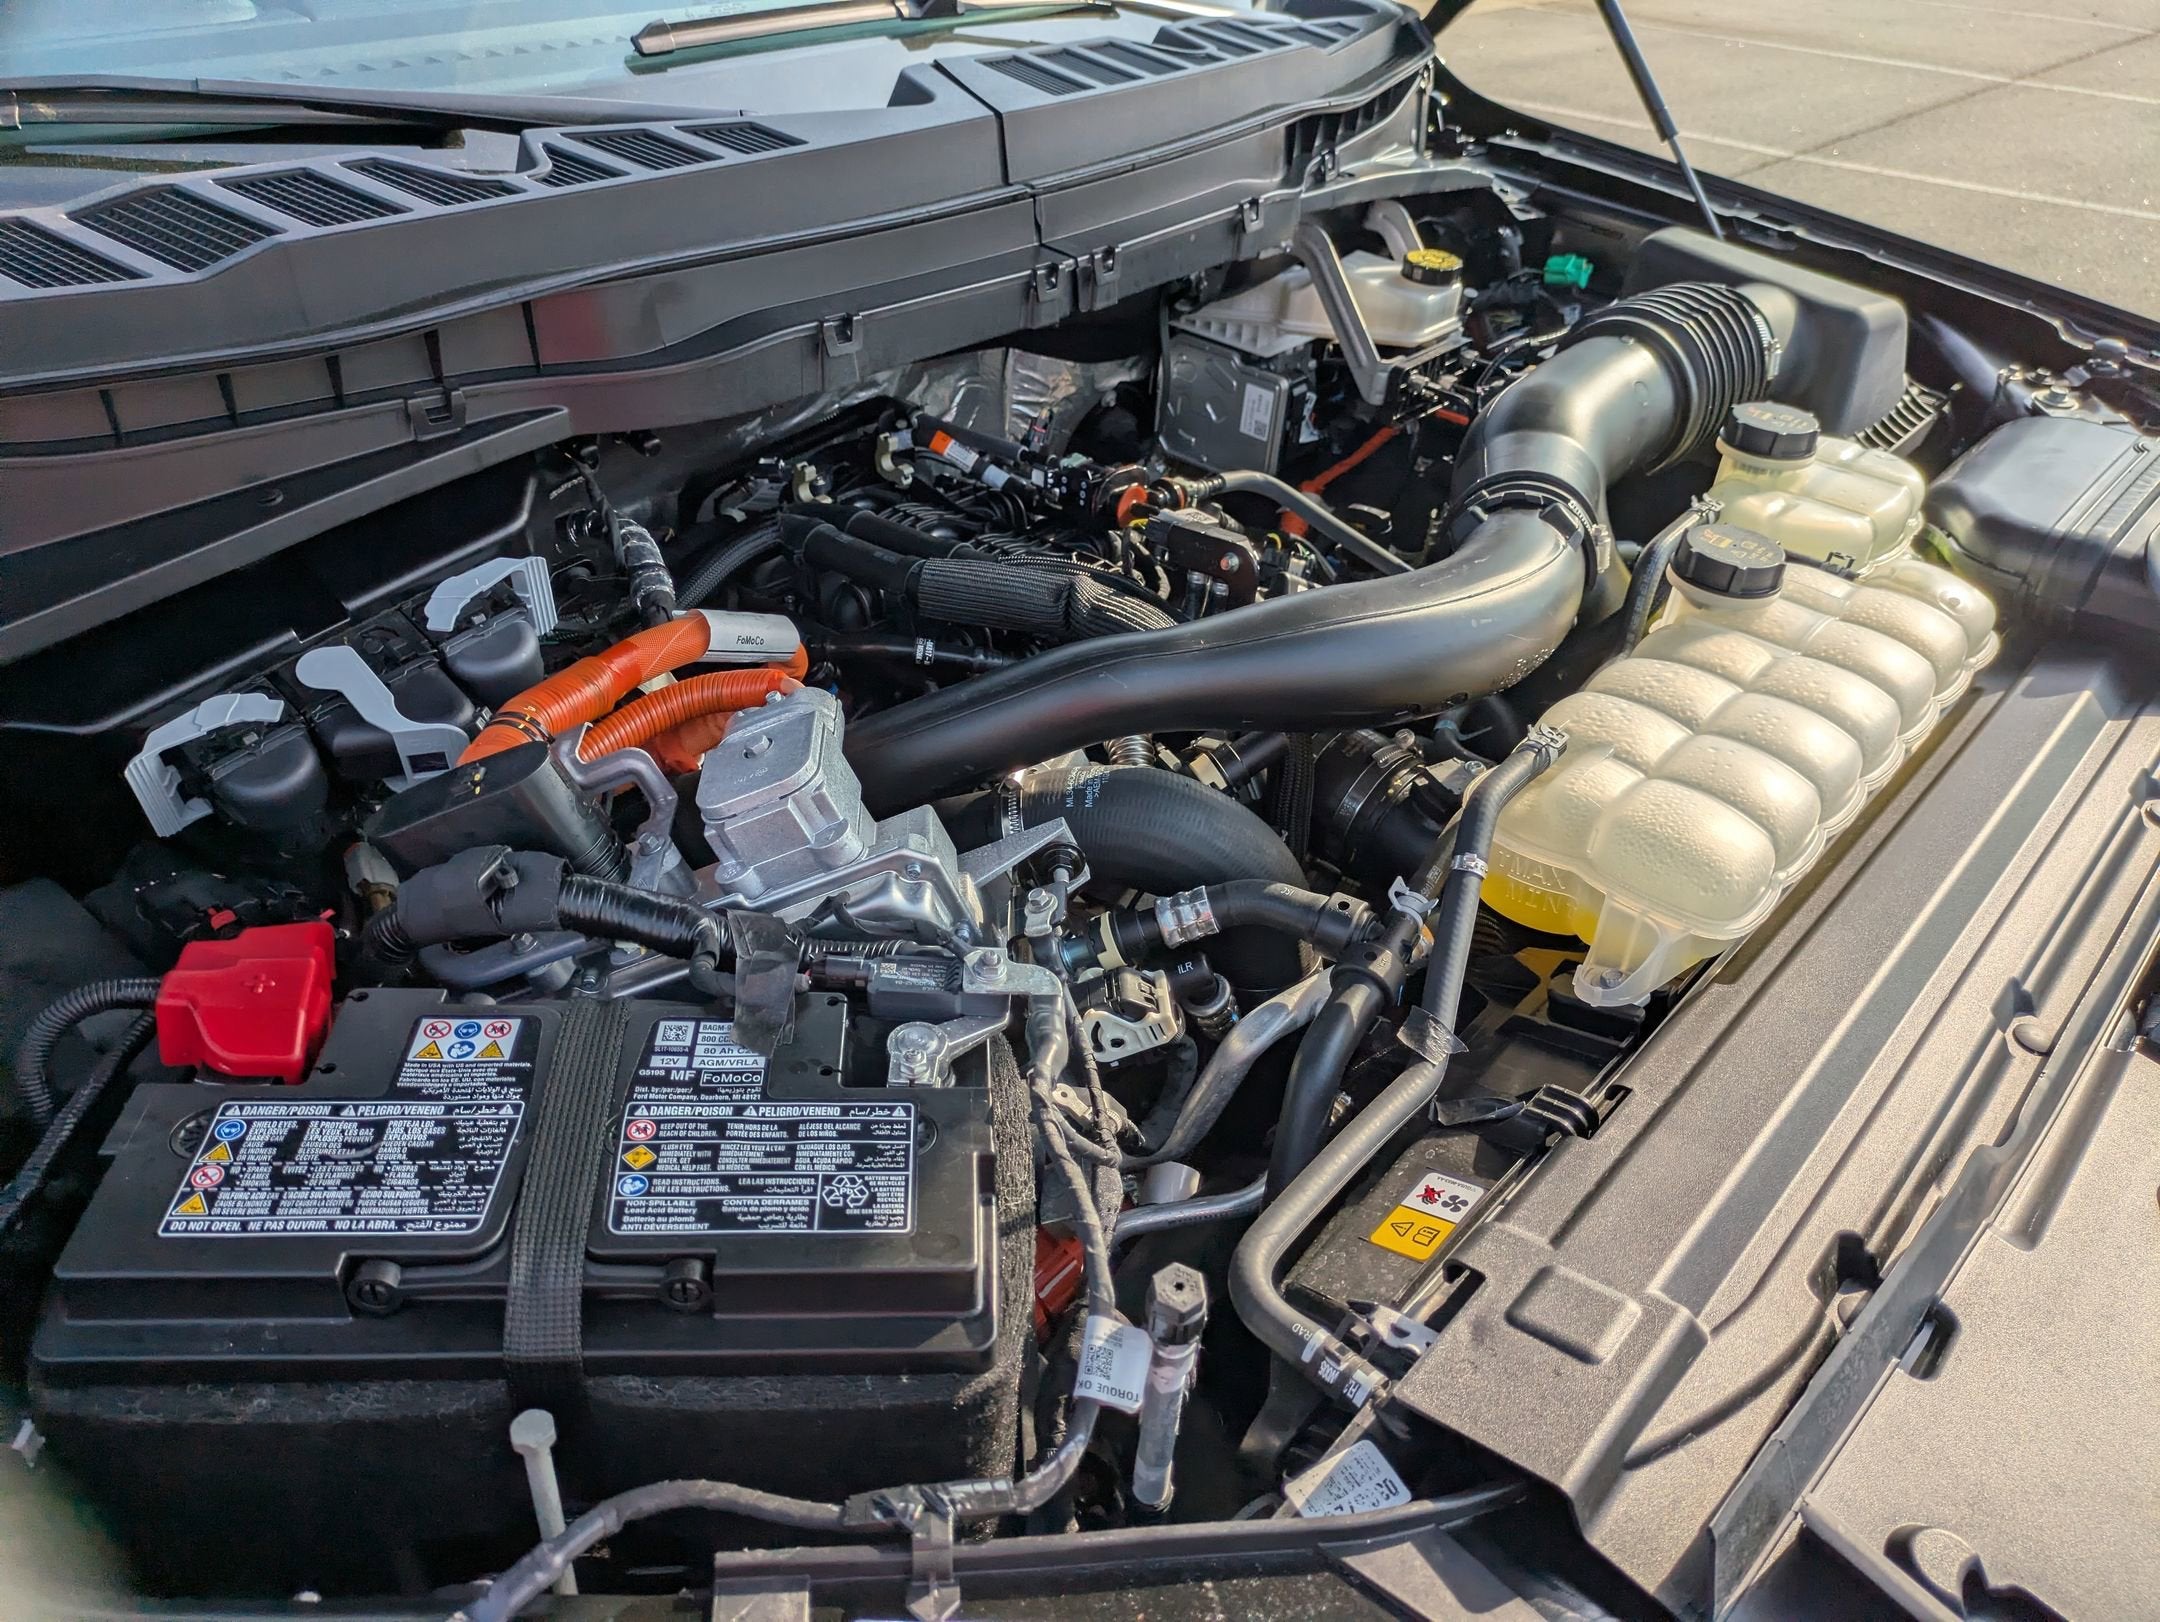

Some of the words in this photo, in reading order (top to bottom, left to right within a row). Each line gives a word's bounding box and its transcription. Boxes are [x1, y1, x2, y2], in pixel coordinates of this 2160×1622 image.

[736, 635, 765, 646] FoMoCo
[1085, 786, 1093, 807] Made
[1178, 962, 1193, 974] ILR
[670, 1070, 696, 1080] MF
[703, 1073, 761, 1082] FoMoCo
[242, 1106, 332, 1116] DANGER/POISON
[357, 1106, 445, 1116] PELIGRO/VENENO
[650, 1106, 733, 1116] DANGER/POISON
[759, 1107, 840, 1116] PELIGRO/VENENO
[278, 1121, 299, 1129] EYES,
[309, 1121, 319, 1129] SE
[320, 1121, 358, 1129] PROTÉGER
[170, 1221, 186, 1231] DO
[188, 1221, 210, 1231] NOT
[212, 1221, 242, 1231] OPEN.
[248, 1221, 262, 1230] NE
[264, 1221, 284, 1230] PAS
[287, 1221, 328, 1230] OUVRIR.
[335, 1220, 350, 1230] NO
[352, 1220, 366, 1229] LA
[367, 1220, 398, 1229] ABRA.
[1292, 1323, 1312, 1341] RAD
[1096, 1383, 1139, 1402] TORQUE
